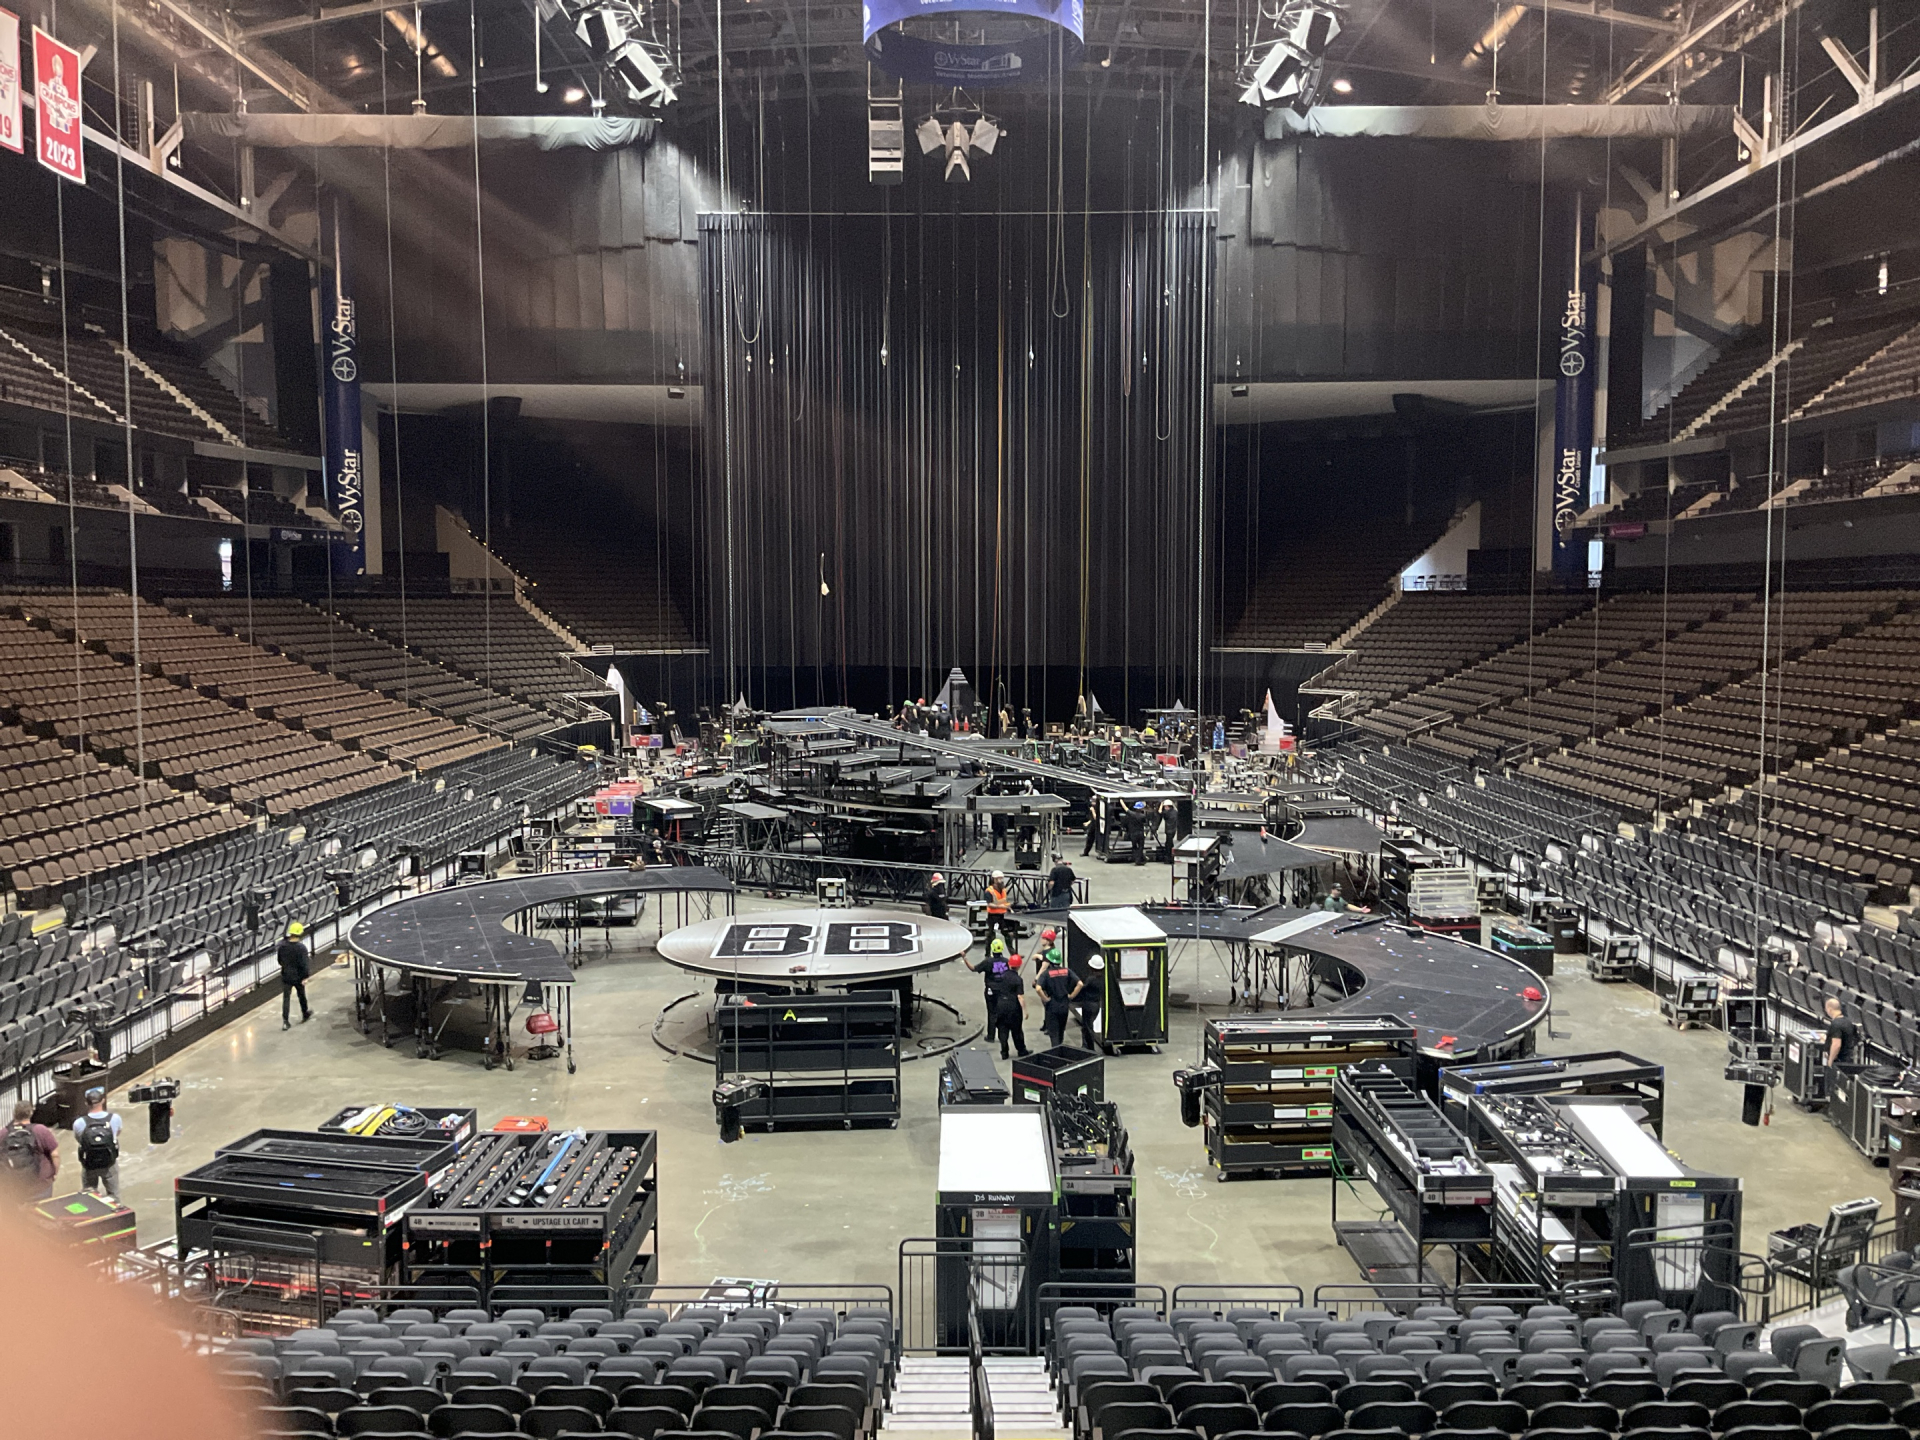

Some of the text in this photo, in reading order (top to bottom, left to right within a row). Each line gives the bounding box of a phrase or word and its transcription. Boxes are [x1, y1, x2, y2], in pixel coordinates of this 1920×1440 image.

[46, 136, 76, 171] 2023
[331, 296, 356, 357] VyStar
[1561, 290, 1586, 353] VyStar
[338, 449, 361, 510] VyStar
[1556, 448, 1580, 509] VyStar
[783, 1009, 796, 1021] A
[532, 1217, 589, 1226] UPSTAGE LX CART
[988, 1194, 1016, 1202] RUNWAY
